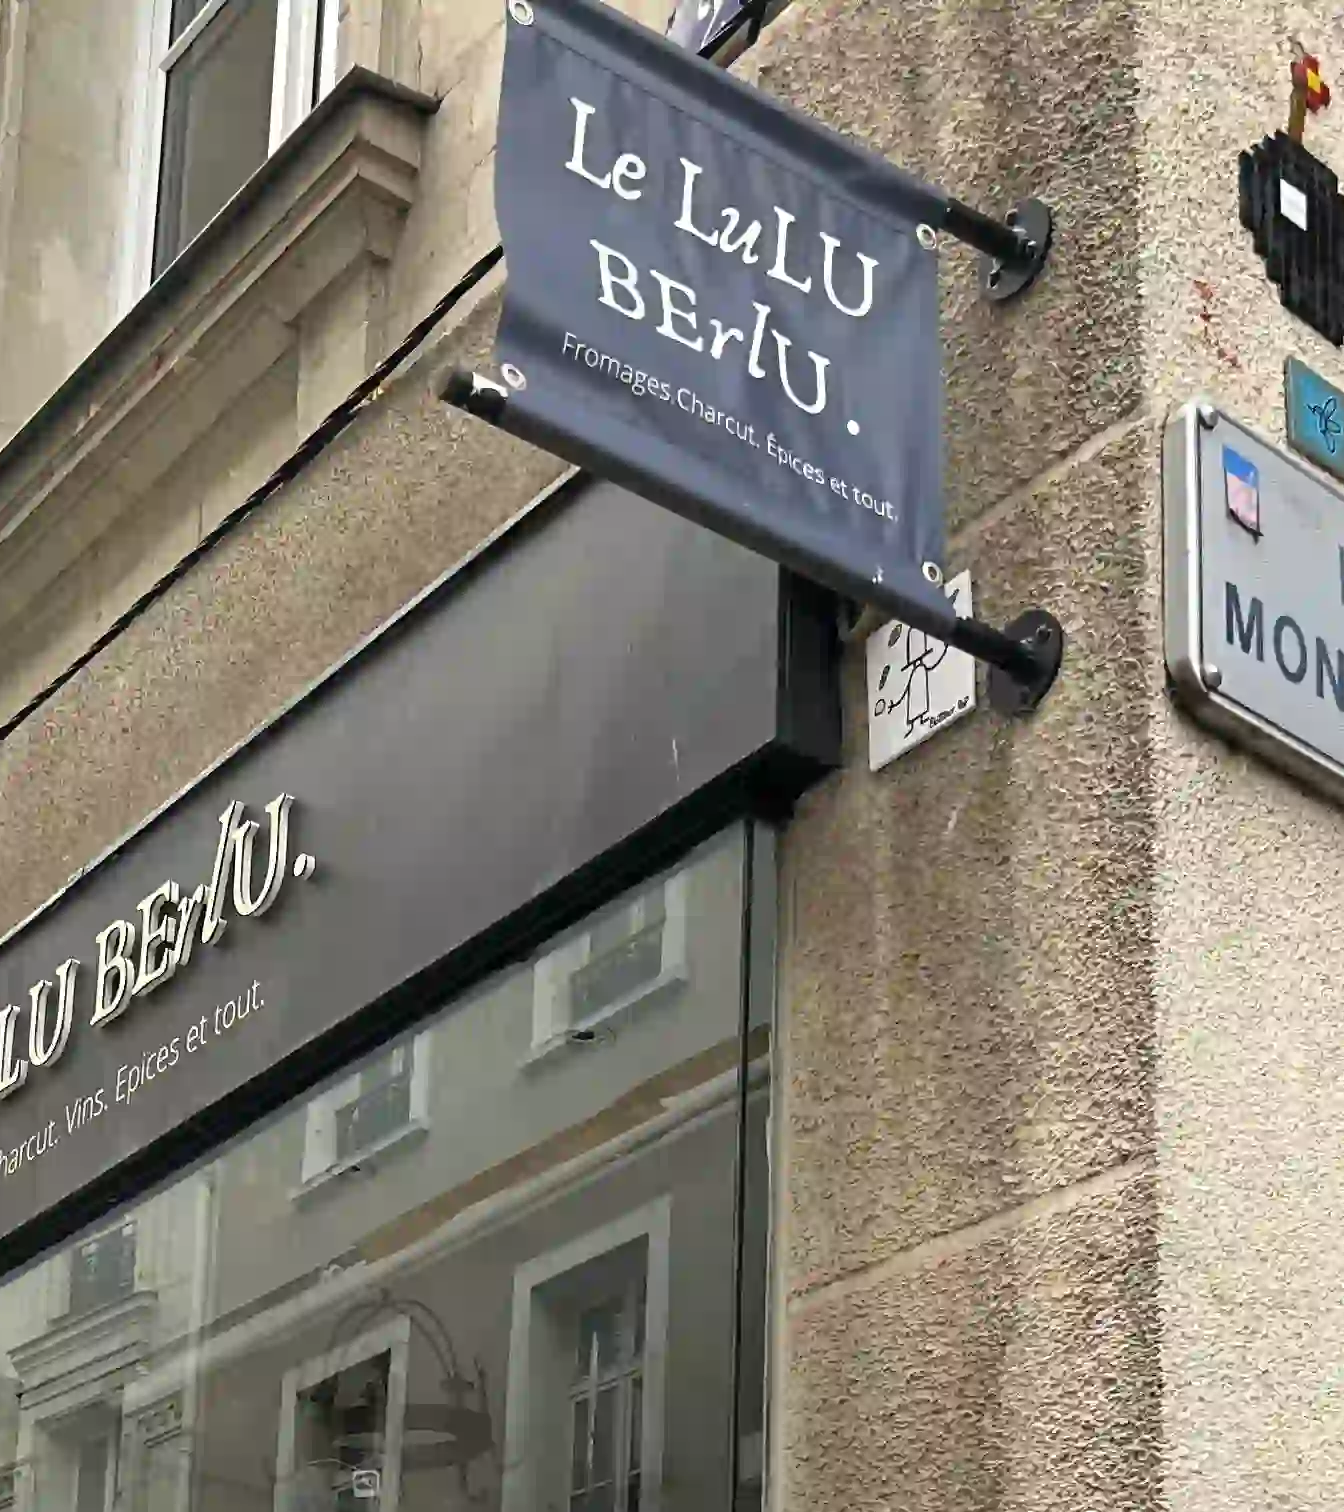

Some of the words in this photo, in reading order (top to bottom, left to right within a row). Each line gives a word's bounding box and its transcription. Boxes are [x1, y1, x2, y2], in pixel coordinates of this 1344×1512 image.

[565, 97, 646, 200] Le
[674, 157, 880, 317] LuLU
[830, 476, 849, 500] et
[186, 1015, 208, 1053] et
[214, 979, 265, 1035] tout.
